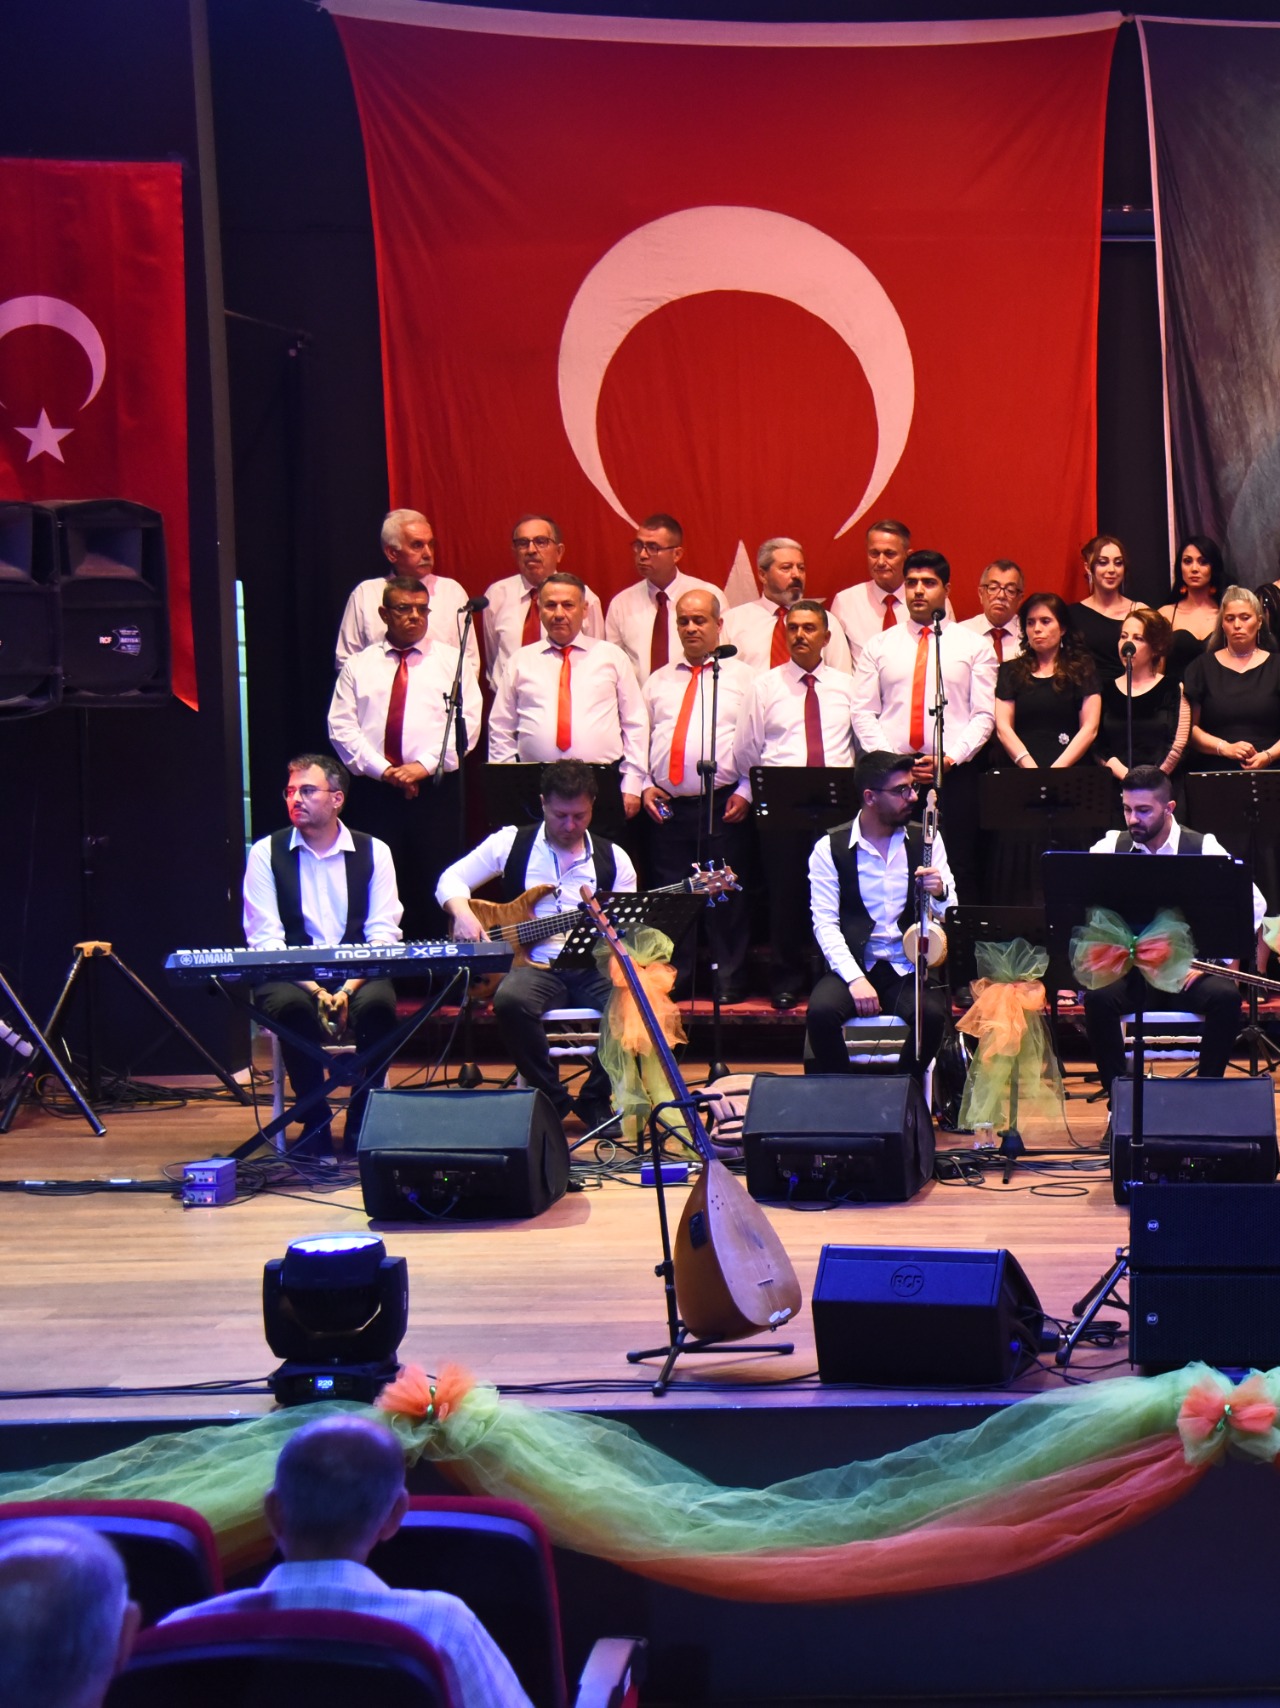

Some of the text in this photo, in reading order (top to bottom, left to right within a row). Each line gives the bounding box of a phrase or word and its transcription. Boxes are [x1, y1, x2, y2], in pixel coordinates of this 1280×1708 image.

[334, 944, 459, 960] MOTIF XF6
[193, 953, 235, 965] YAMAHA
[893, 1274, 923, 1289] RCF
[317, 1379, 334, 1387] 220
